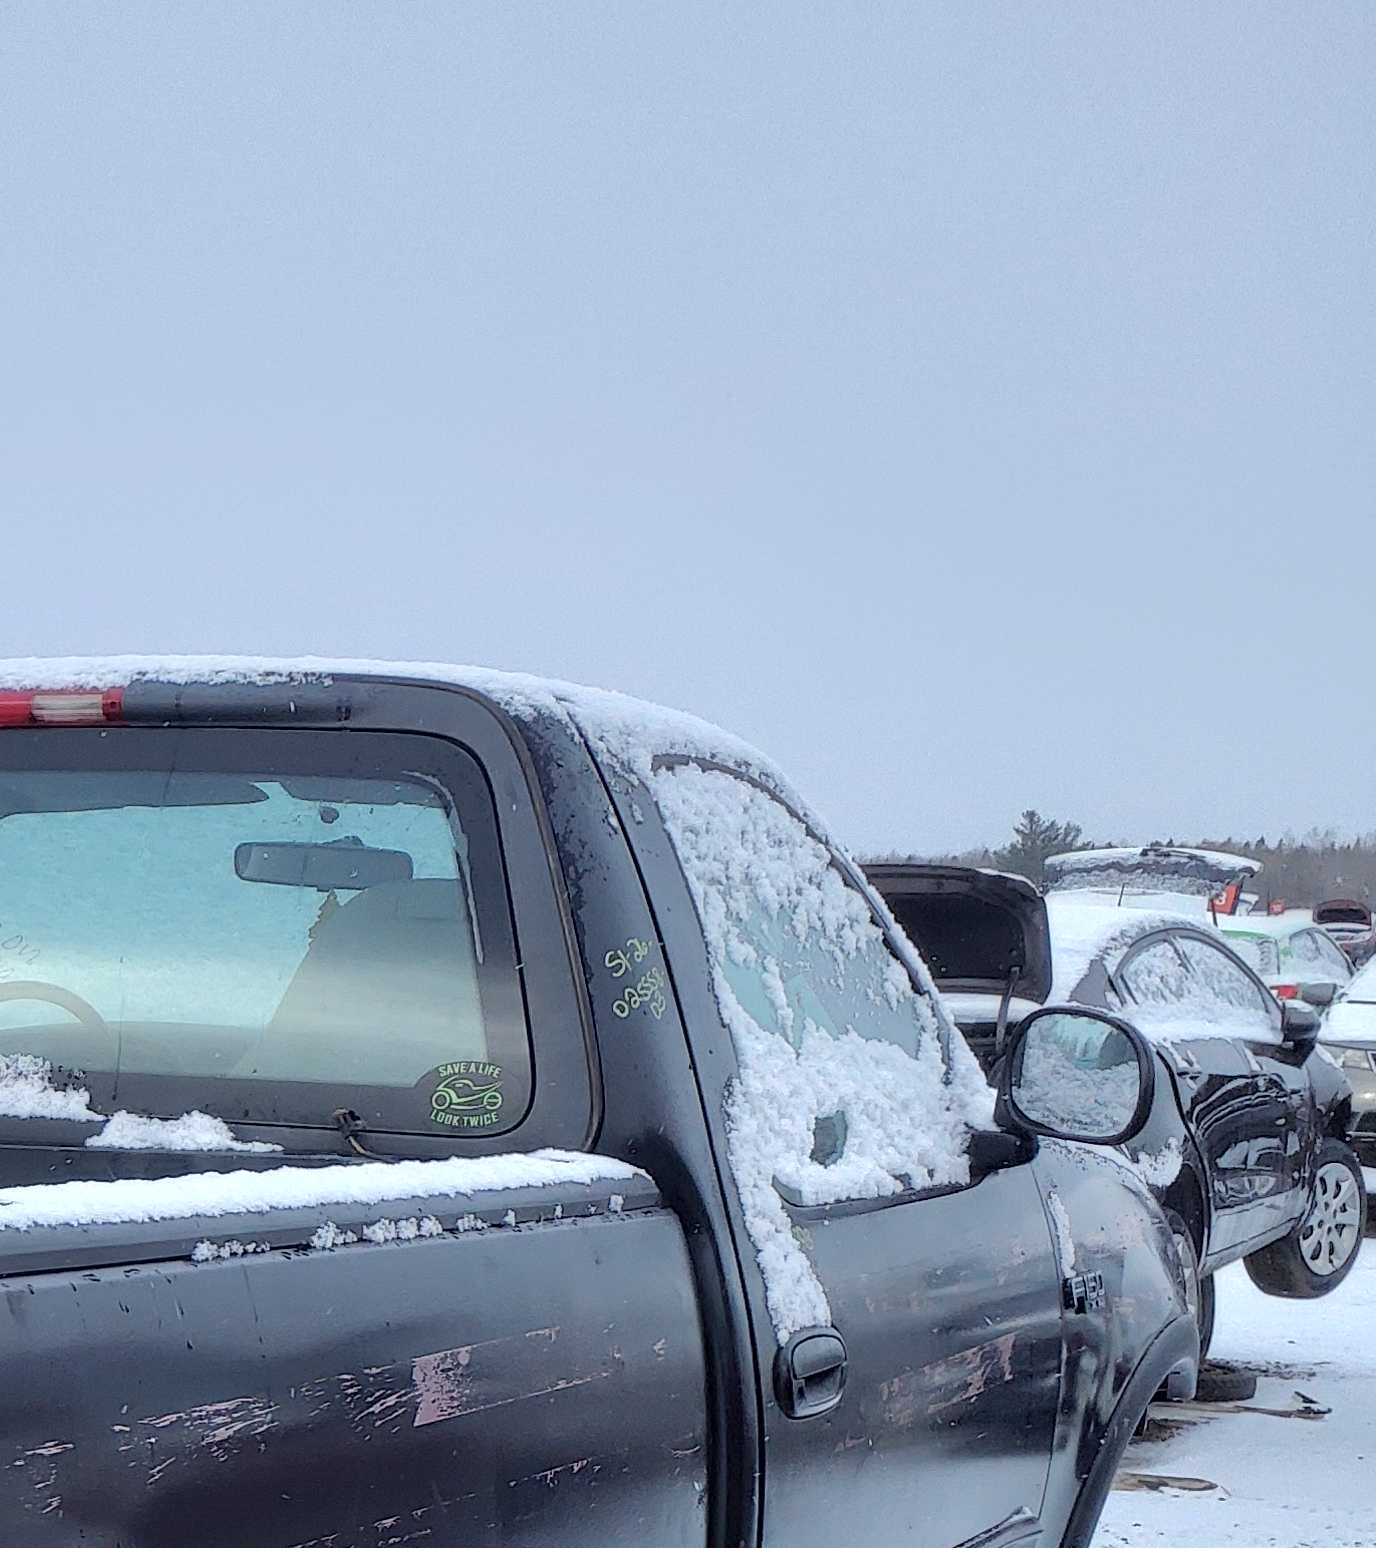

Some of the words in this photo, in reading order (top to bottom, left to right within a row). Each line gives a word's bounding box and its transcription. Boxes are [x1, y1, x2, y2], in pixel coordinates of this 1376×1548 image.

[438, 1062, 466, 1077] SAVE
[468, 1062, 476, 1073] A
[478, 1063, 502, 1079] LIFE
[430, 1109, 459, 1127] LOOK
[463, 1112, 500, 1127] TWICE
